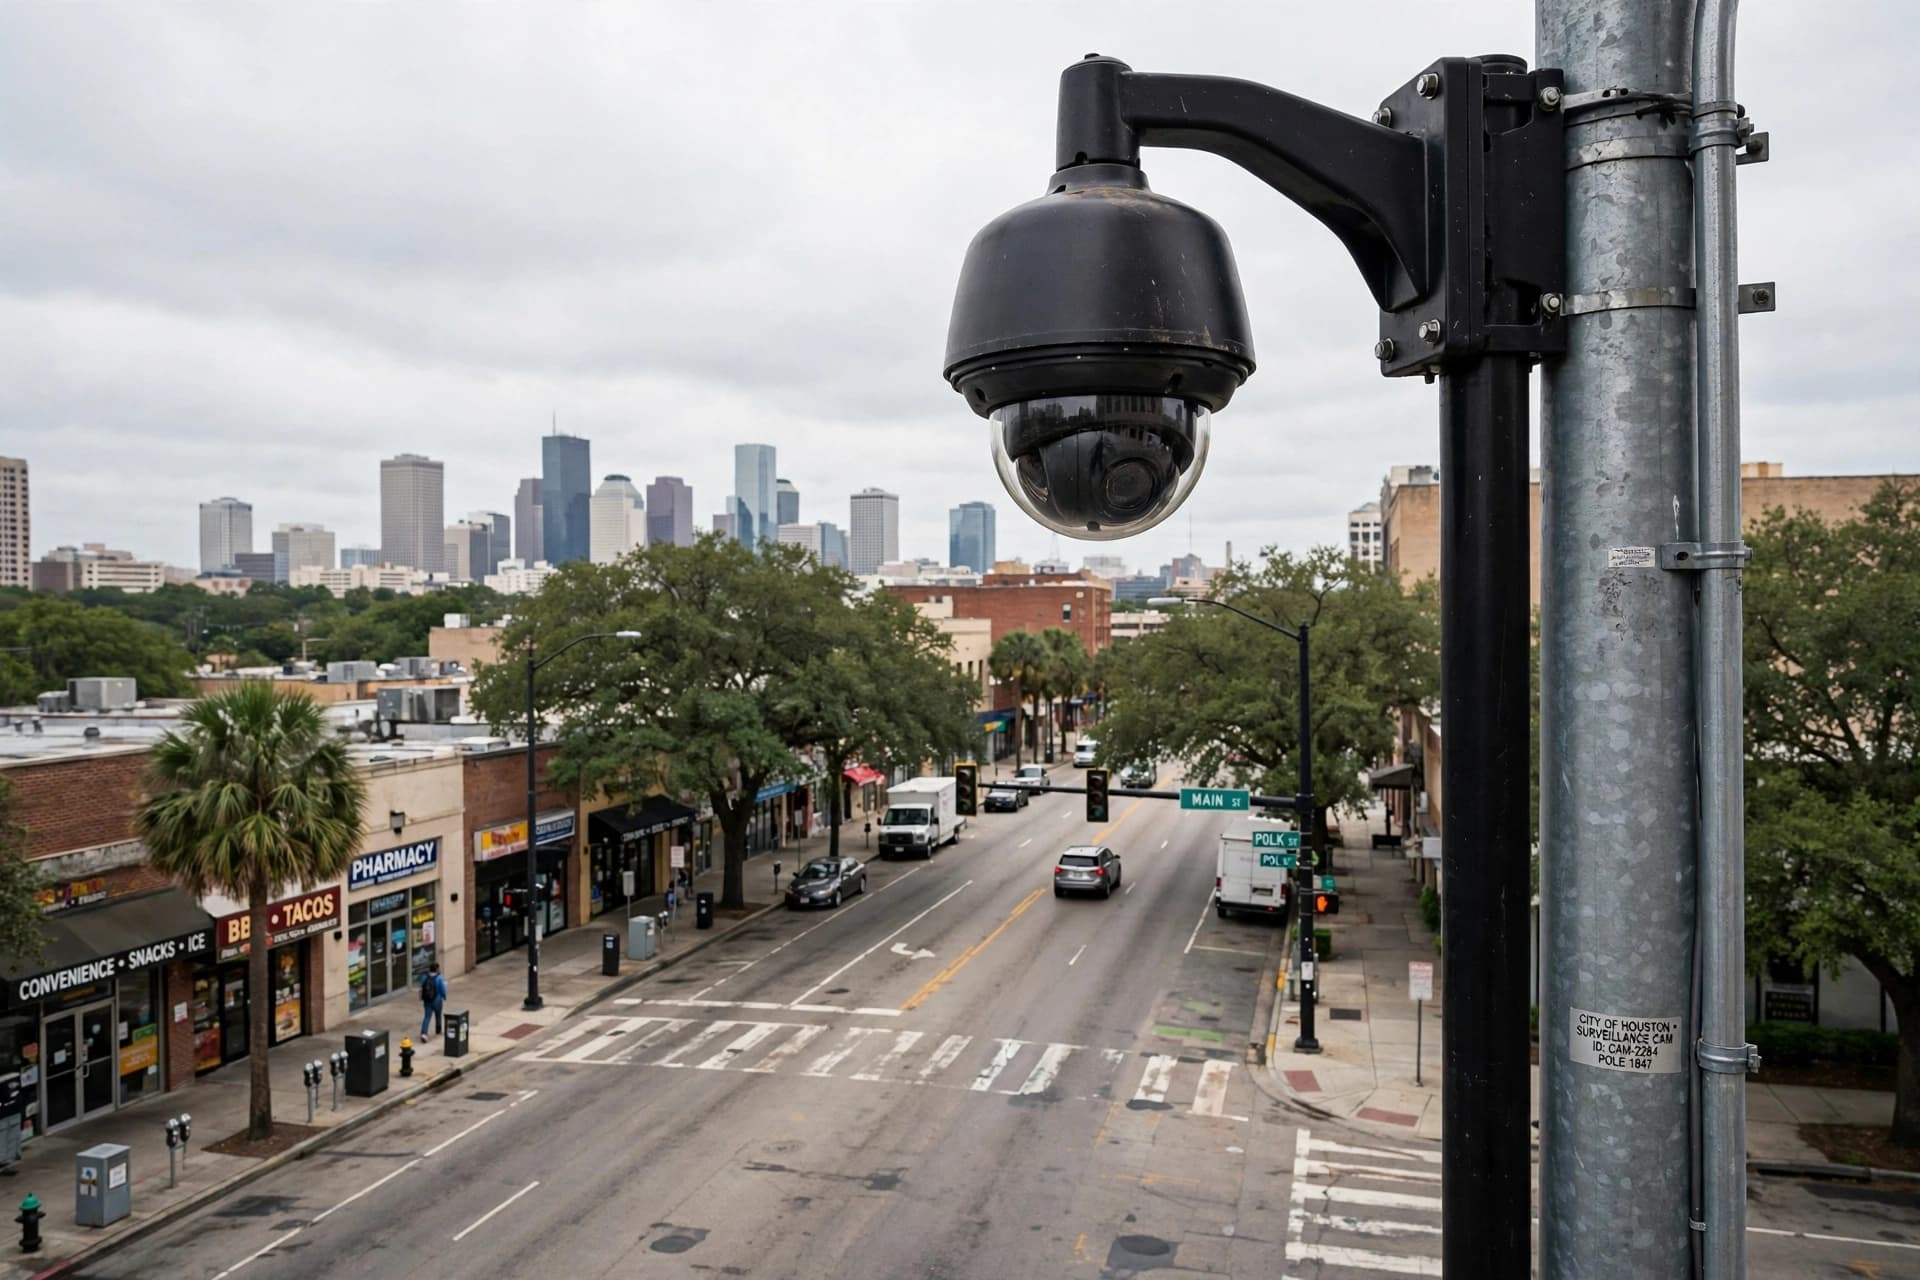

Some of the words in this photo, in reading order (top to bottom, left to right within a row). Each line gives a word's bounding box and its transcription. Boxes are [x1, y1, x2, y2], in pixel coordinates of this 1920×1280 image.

[1192, 793, 1223, 807] MAIN
[1255, 833, 1284, 846] POLK
[352, 841, 434, 881] PHARMACY
[228, 915, 251, 943] BB
[283, 893, 334, 927] TACOS
[19, 958, 115, 1001] CONVENIENCE
[128, 941, 176, 970] SNACKS
[187, 933, 206, 953] ICE
[1579, 1013, 1601, 1027] CITY
[1604, 1018, 1619, 1029] OF
[1621, 1020, 1670, 1033] HOUSTON
[1577, 1025, 1649, 1044] SURVEILLANCE
[1653, 1033, 1673, 1044] CAM
[1592, 1041, 1605, 1052] ID:
[1608, 1044, 1658, 1057] CAM-2284
[1598, 1054, 1626, 1067] POLE
[1629, 1058, 1652, 1069] 1847
